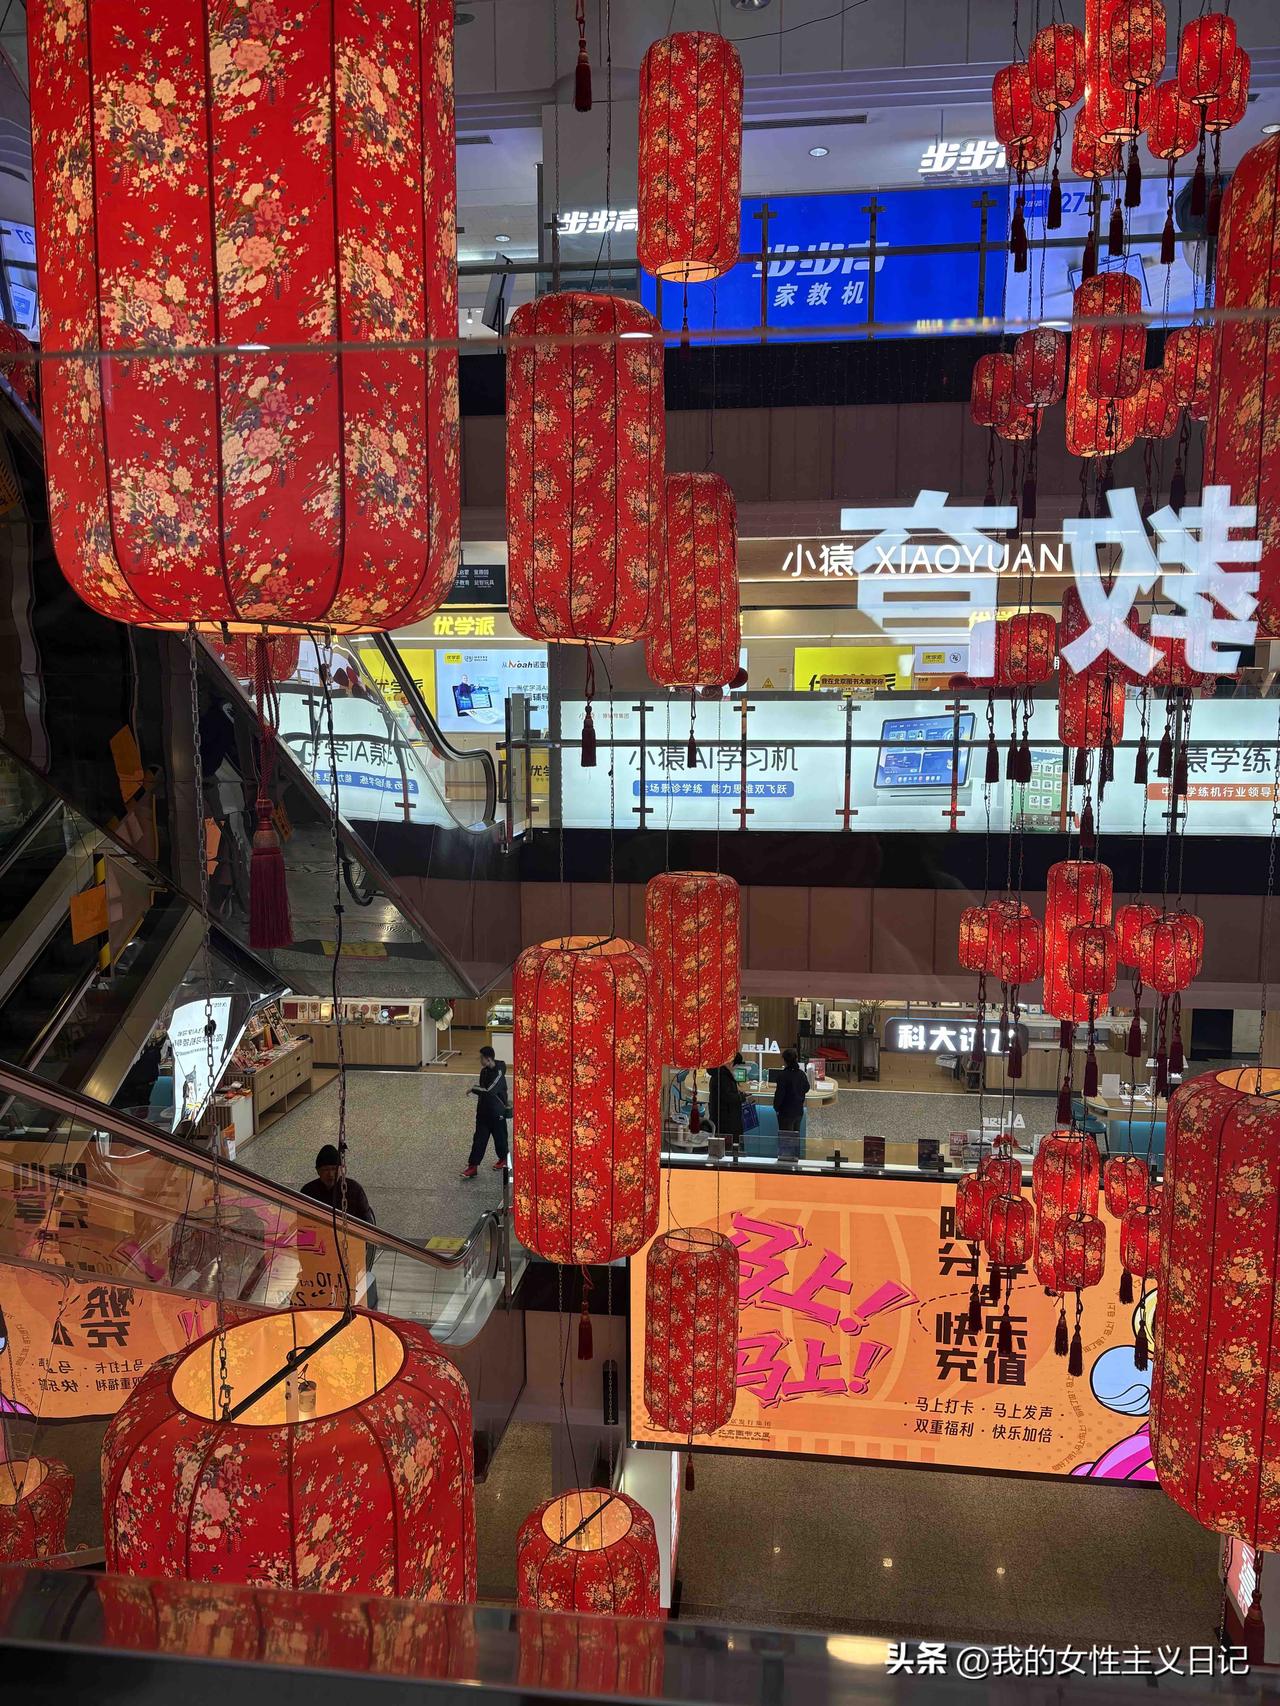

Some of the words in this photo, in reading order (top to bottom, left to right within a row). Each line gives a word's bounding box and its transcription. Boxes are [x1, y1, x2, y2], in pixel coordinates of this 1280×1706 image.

[917, 141, 1006, 173] 步步
[773, 280, 864, 308] 家教机
[781, 541, 855, 577] 小猿
[873, 543, 1065, 576] XIAOYUAN
[432, 615, 496, 636] 优学派
[628, 746, 799, 772] 小猿AI学习机
[1146, 747, 1280, 774] 猿学练
[1161, 786, 1280, 798] 中学练机行业领导
[935, 1310, 1028, 1350] 快乐
[935, 1347, 1027, 1387] 充值
[915, 1396, 975, 1416] 马上打卡
[993, 1401, 1054, 1421] 马上发声
[913, 1417, 975, 1438] 双重福利
[991, 1422, 1053, 1444] 快乐加倍
